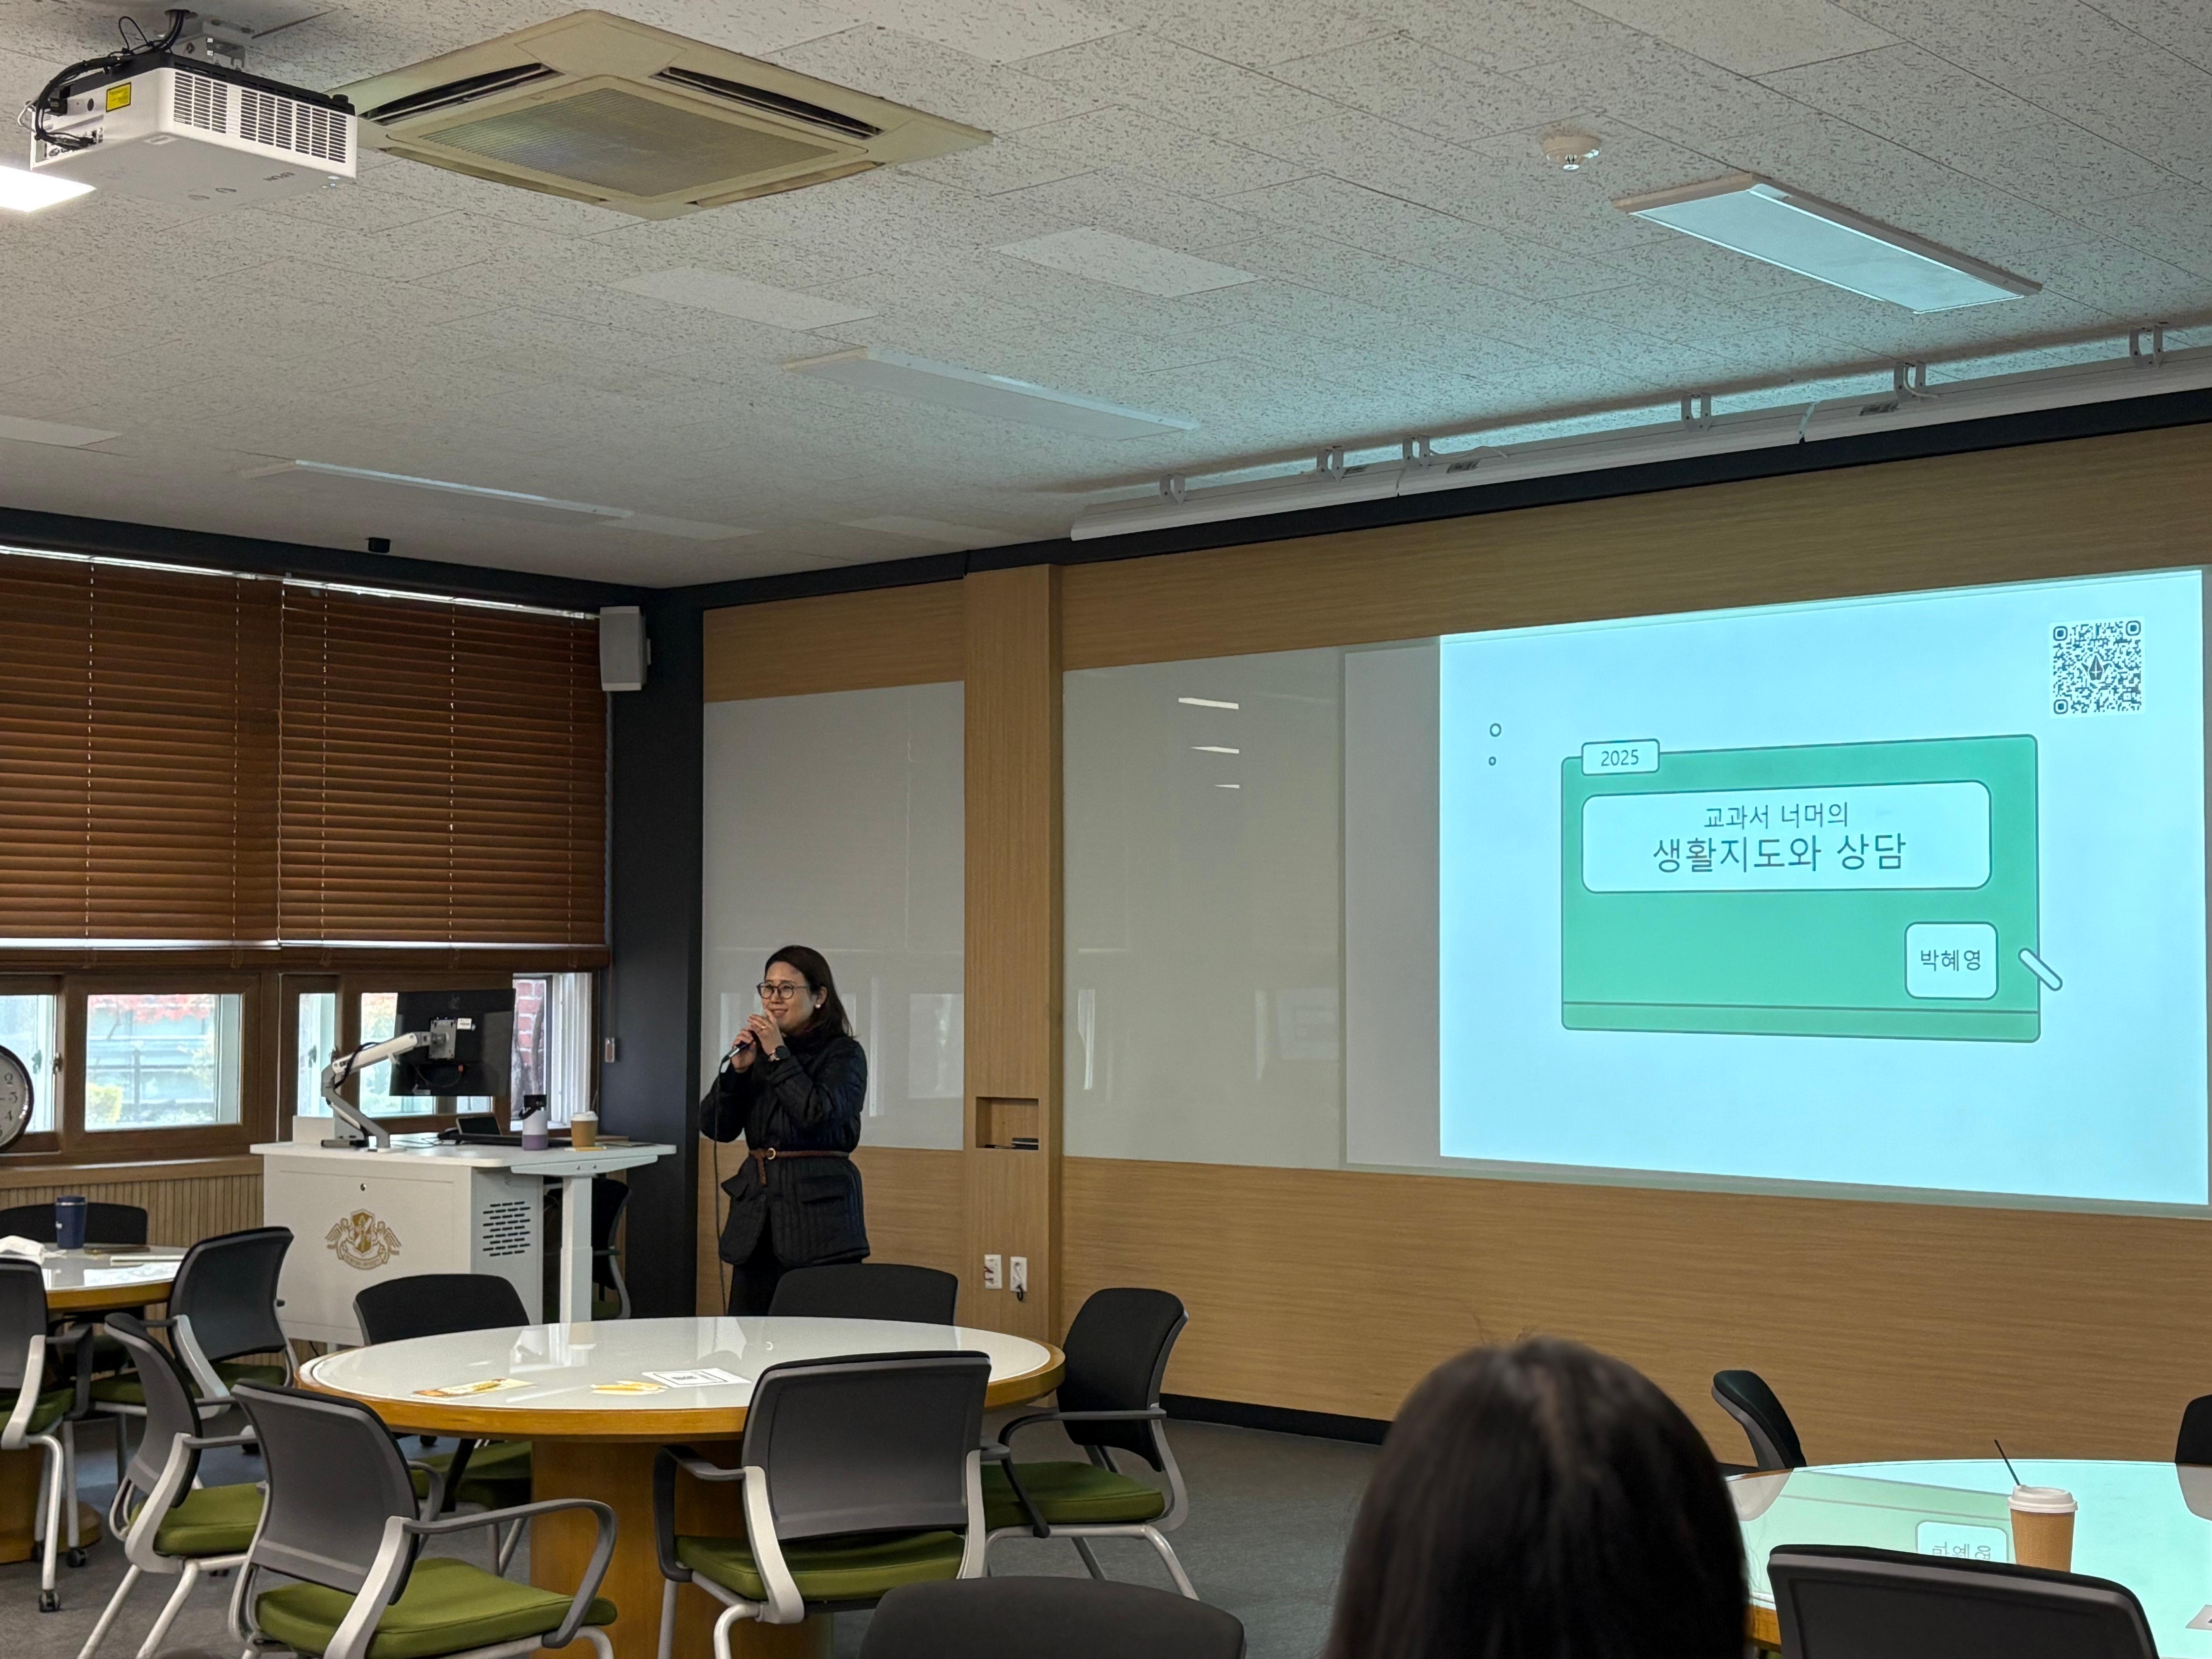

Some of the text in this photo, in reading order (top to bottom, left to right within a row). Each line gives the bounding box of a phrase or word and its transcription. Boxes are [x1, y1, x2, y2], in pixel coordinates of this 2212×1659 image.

[1601, 749, 1639, 766] 2025
[1704, 802, 1848, 830] 교과서 너머의
[1653, 833, 1907, 873] 생활지도와 상담
[1920, 949, 1981, 972] 박혜영
